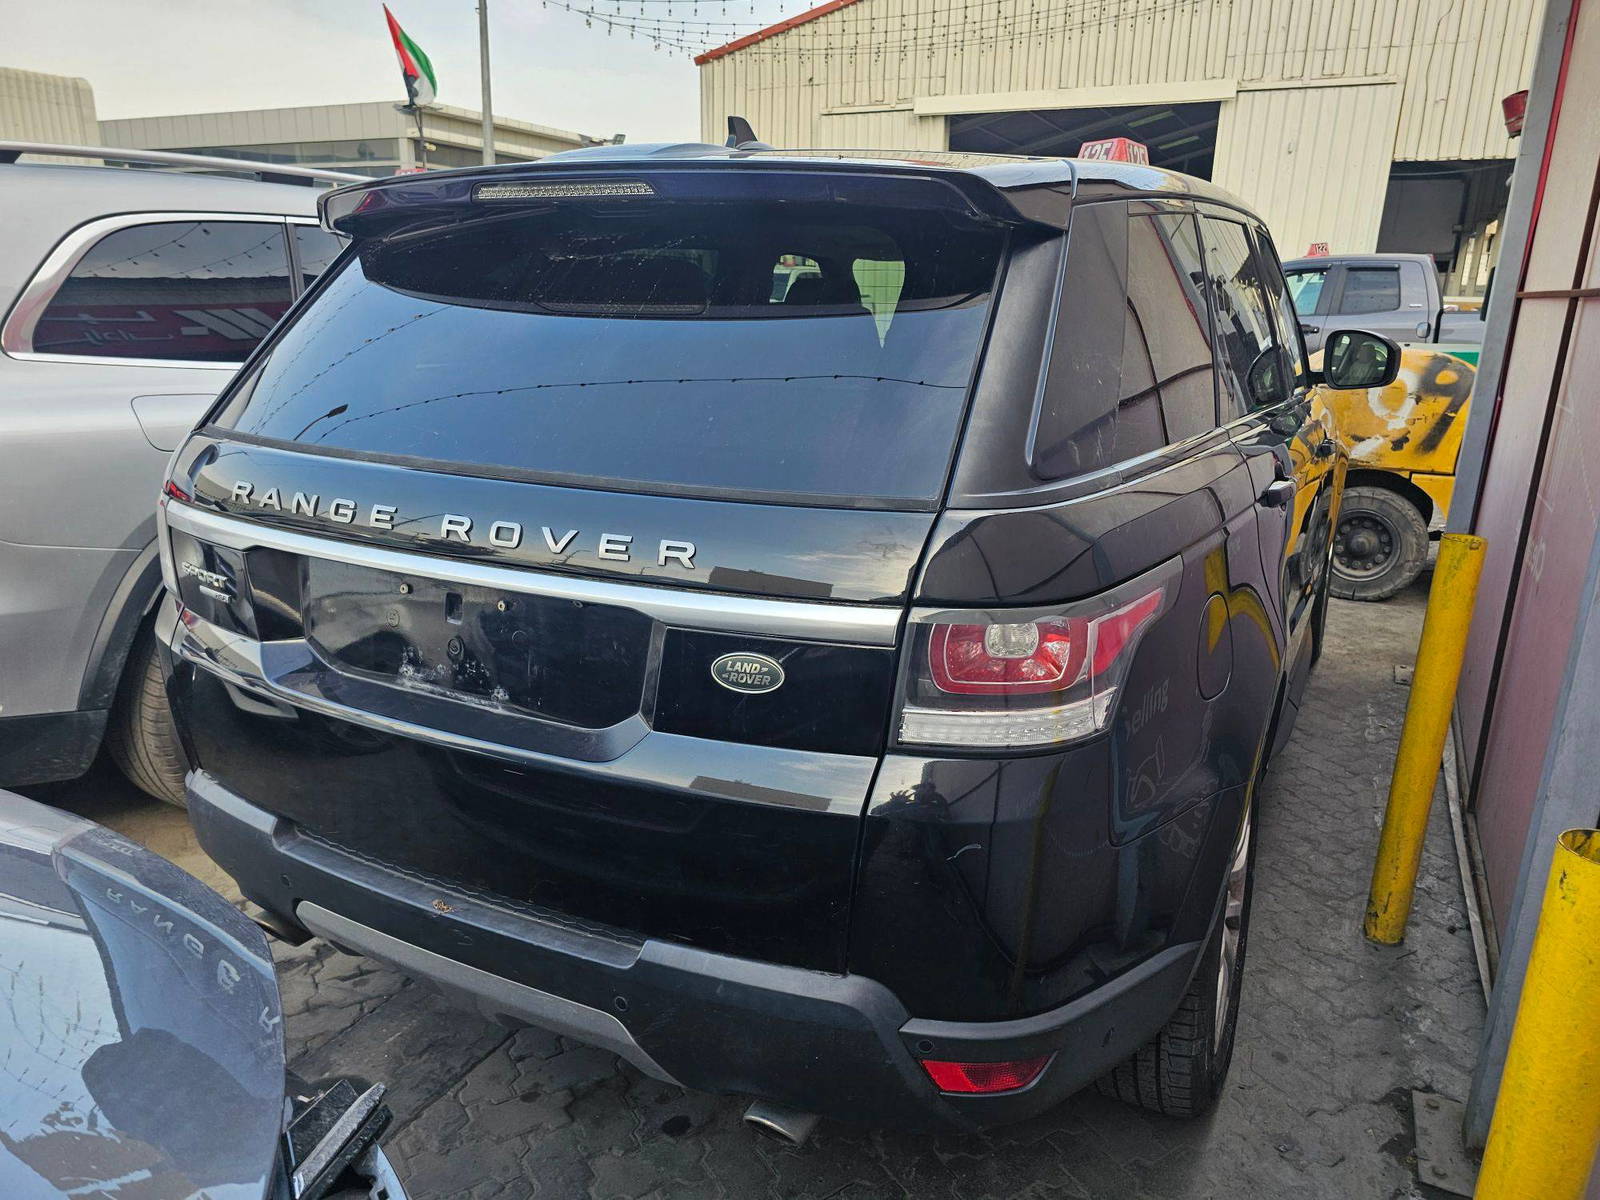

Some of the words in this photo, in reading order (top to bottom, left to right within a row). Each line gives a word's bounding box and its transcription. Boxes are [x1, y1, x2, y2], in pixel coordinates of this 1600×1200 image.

[231, 480, 398, 530] RANGE
[440, 513, 697, 569] ROVER
[182, 562, 228, 588] SPORT
[726, 661, 760, 674] LAND
[728, 672, 771, 686] ROVER
